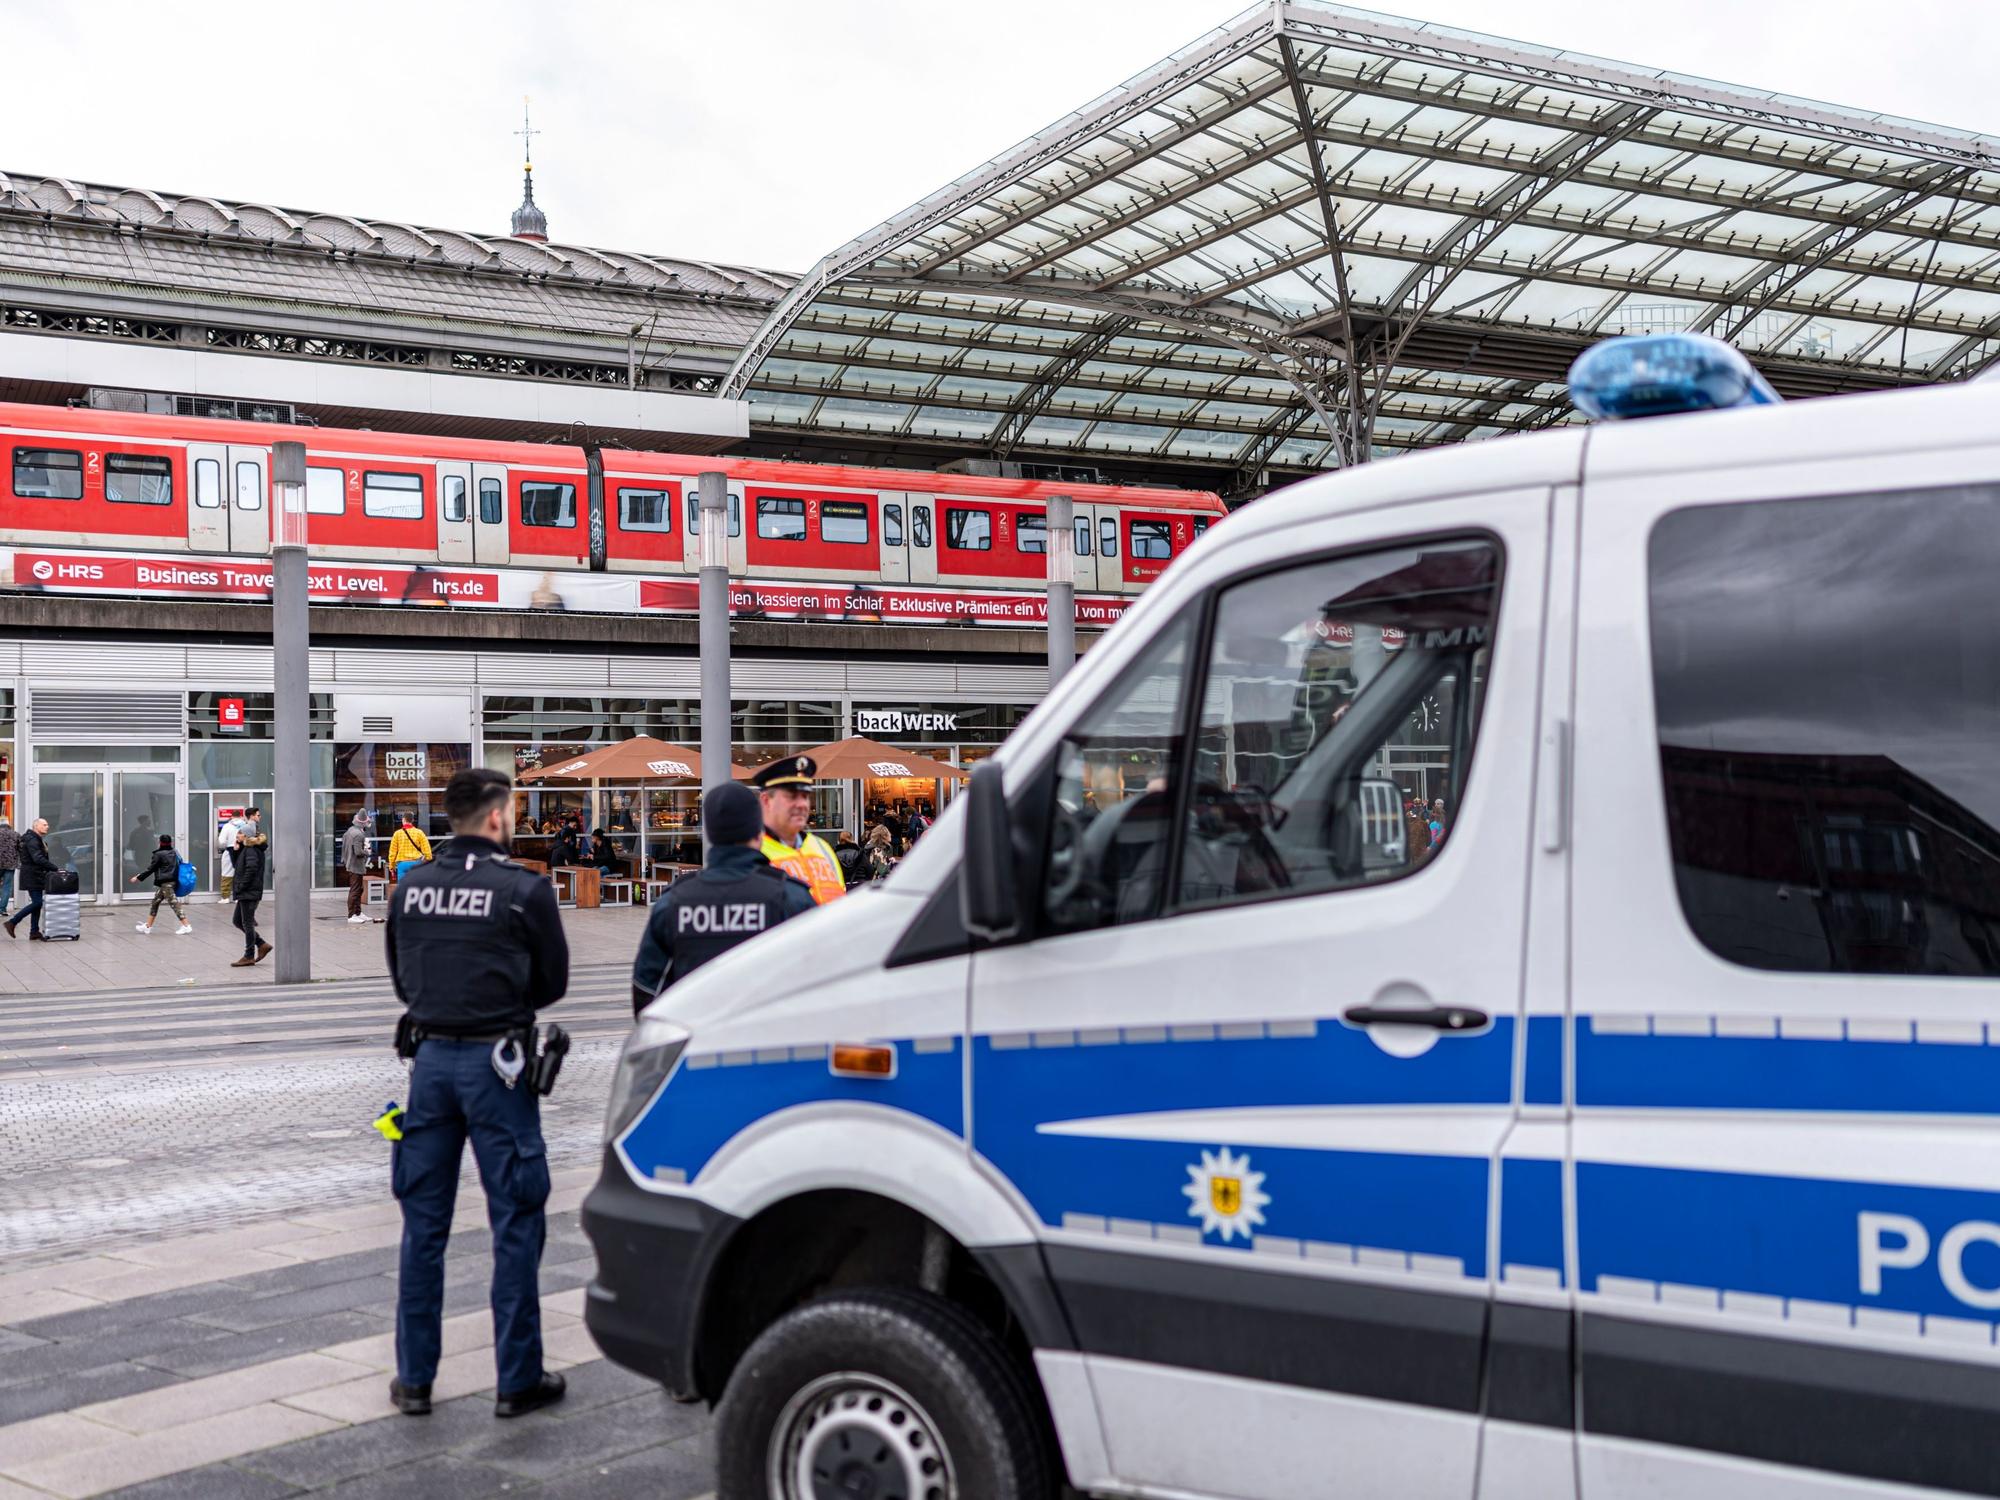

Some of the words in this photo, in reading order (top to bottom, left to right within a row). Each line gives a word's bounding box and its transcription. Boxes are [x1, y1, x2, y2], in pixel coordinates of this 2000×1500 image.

[88, 451, 98, 467] 2
[349, 470, 358, 484] 2
[809, 501, 817, 513] 2
[1000, 512, 1007, 525] 2
[1177, 523, 1184, 535] 2
[58, 564, 104, 580] HRS
[137, 567, 219, 586] Business
[222, 570, 274, 588] Trave
[307, 574, 333, 590] ext
[337, 575, 389, 592] Level.
[432, 578, 484, 596] hrs.de
[756, 591, 820, 608] kassieren
[824, 594, 841, 609] im
[844, 595, 886, 611] Schlaf.
[890, 597, 953, 613] Exklusive
[955, 600, 1012, 616] Prämien:
[1014, 602, 1034, 616] ein
[1081, 607, 1105, 618] von
[860, 713, 900, 730] back
[903, 713, 957, 731] WERK
[388, 753, 424, 767] back
[386, 769, 425, 780] WERK
[364, 856, 374, 869] 4
[403, 887, 493, 917] POLIZEI
[678, 903, 766, 933] POLIZEI
[1857, 1210, 2000, 1311] PO
